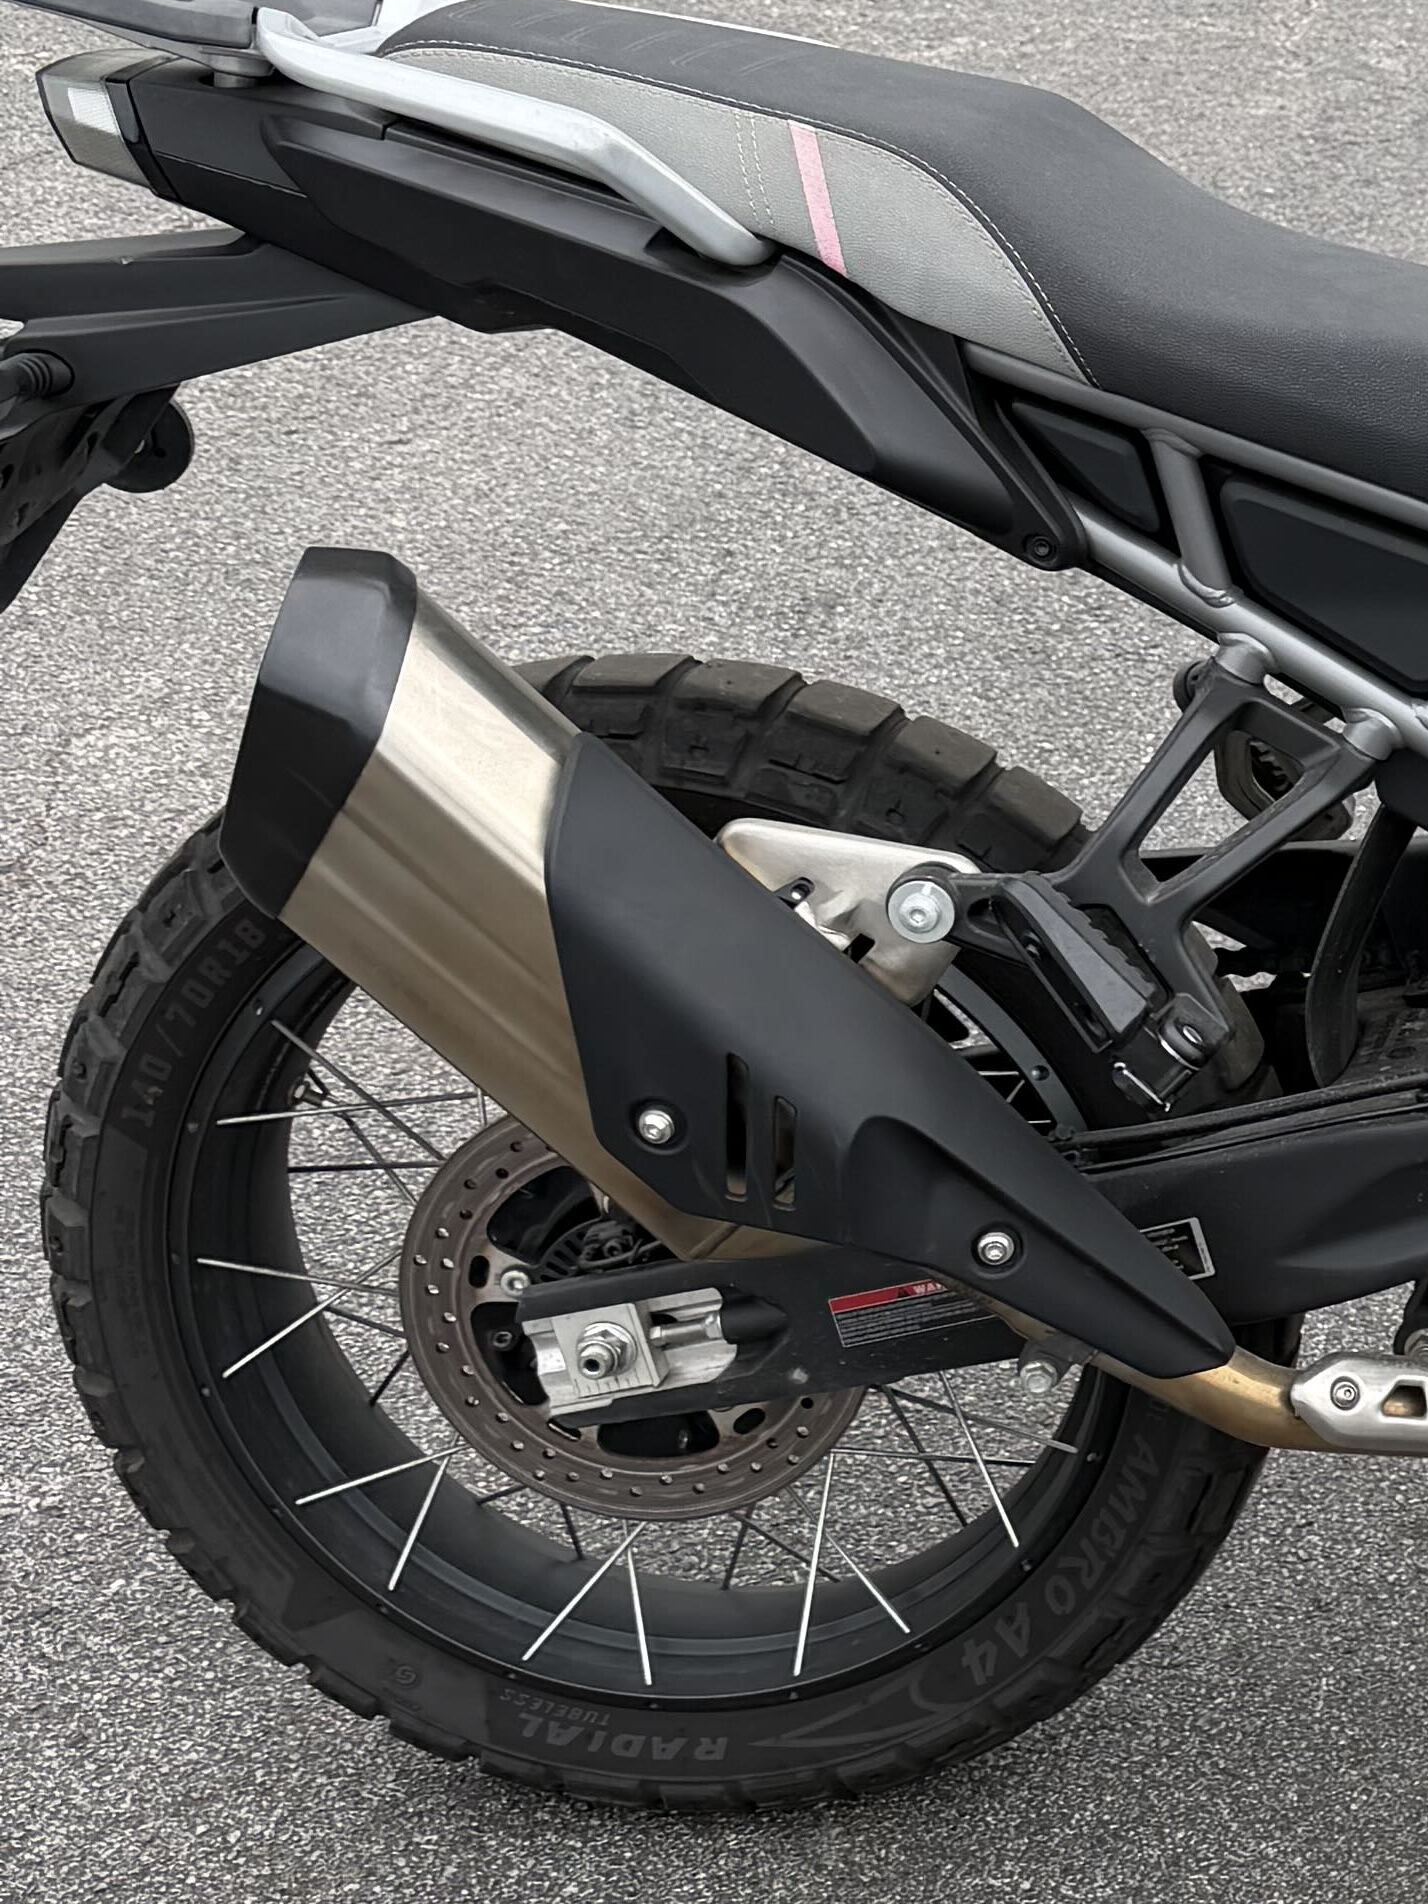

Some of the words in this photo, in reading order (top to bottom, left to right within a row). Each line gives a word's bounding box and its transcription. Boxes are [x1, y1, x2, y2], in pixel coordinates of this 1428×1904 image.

[1044, 1432, 1160, 1616] AMBRO
[499, 1688, 611, 1727] TUBELESS
[517, 1712, 729, 1761] RADIAL
